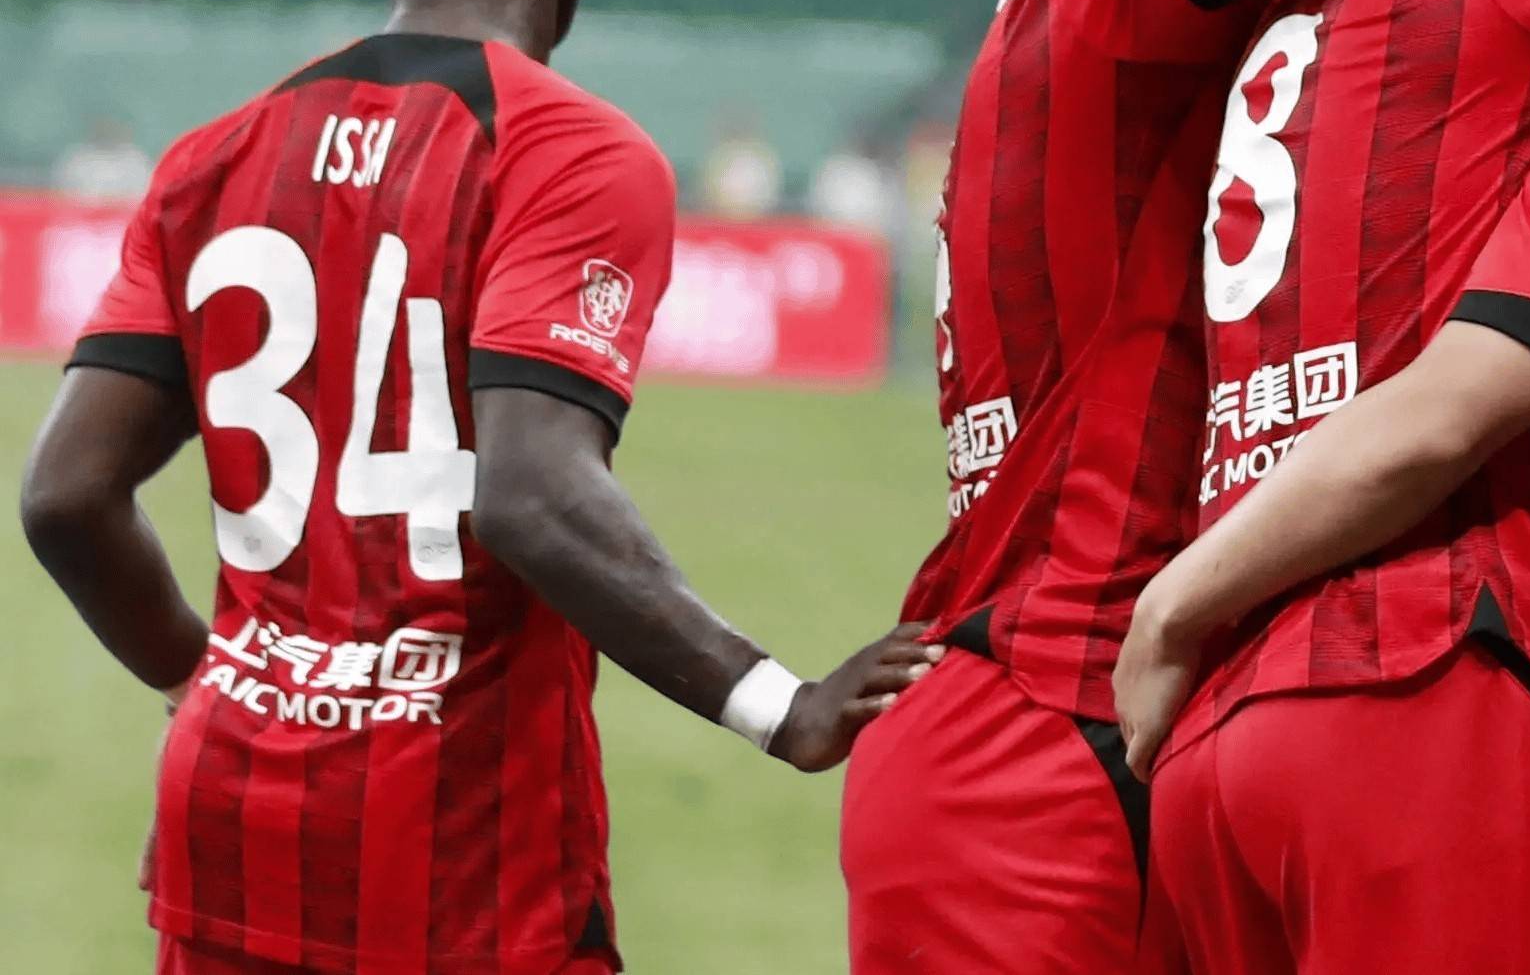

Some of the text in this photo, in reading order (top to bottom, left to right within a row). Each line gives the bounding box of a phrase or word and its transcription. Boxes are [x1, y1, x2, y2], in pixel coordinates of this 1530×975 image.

[312, 114, 396, 188] ISSA
[1204, 13, 1322, 322] 8
[186, 226, 475, 580] 34
[1224, 430, 1312, 490] MOT
[209, 616, 463, 691] 上汽集团
[200, 654, 442, 730] AIC MOTOR
